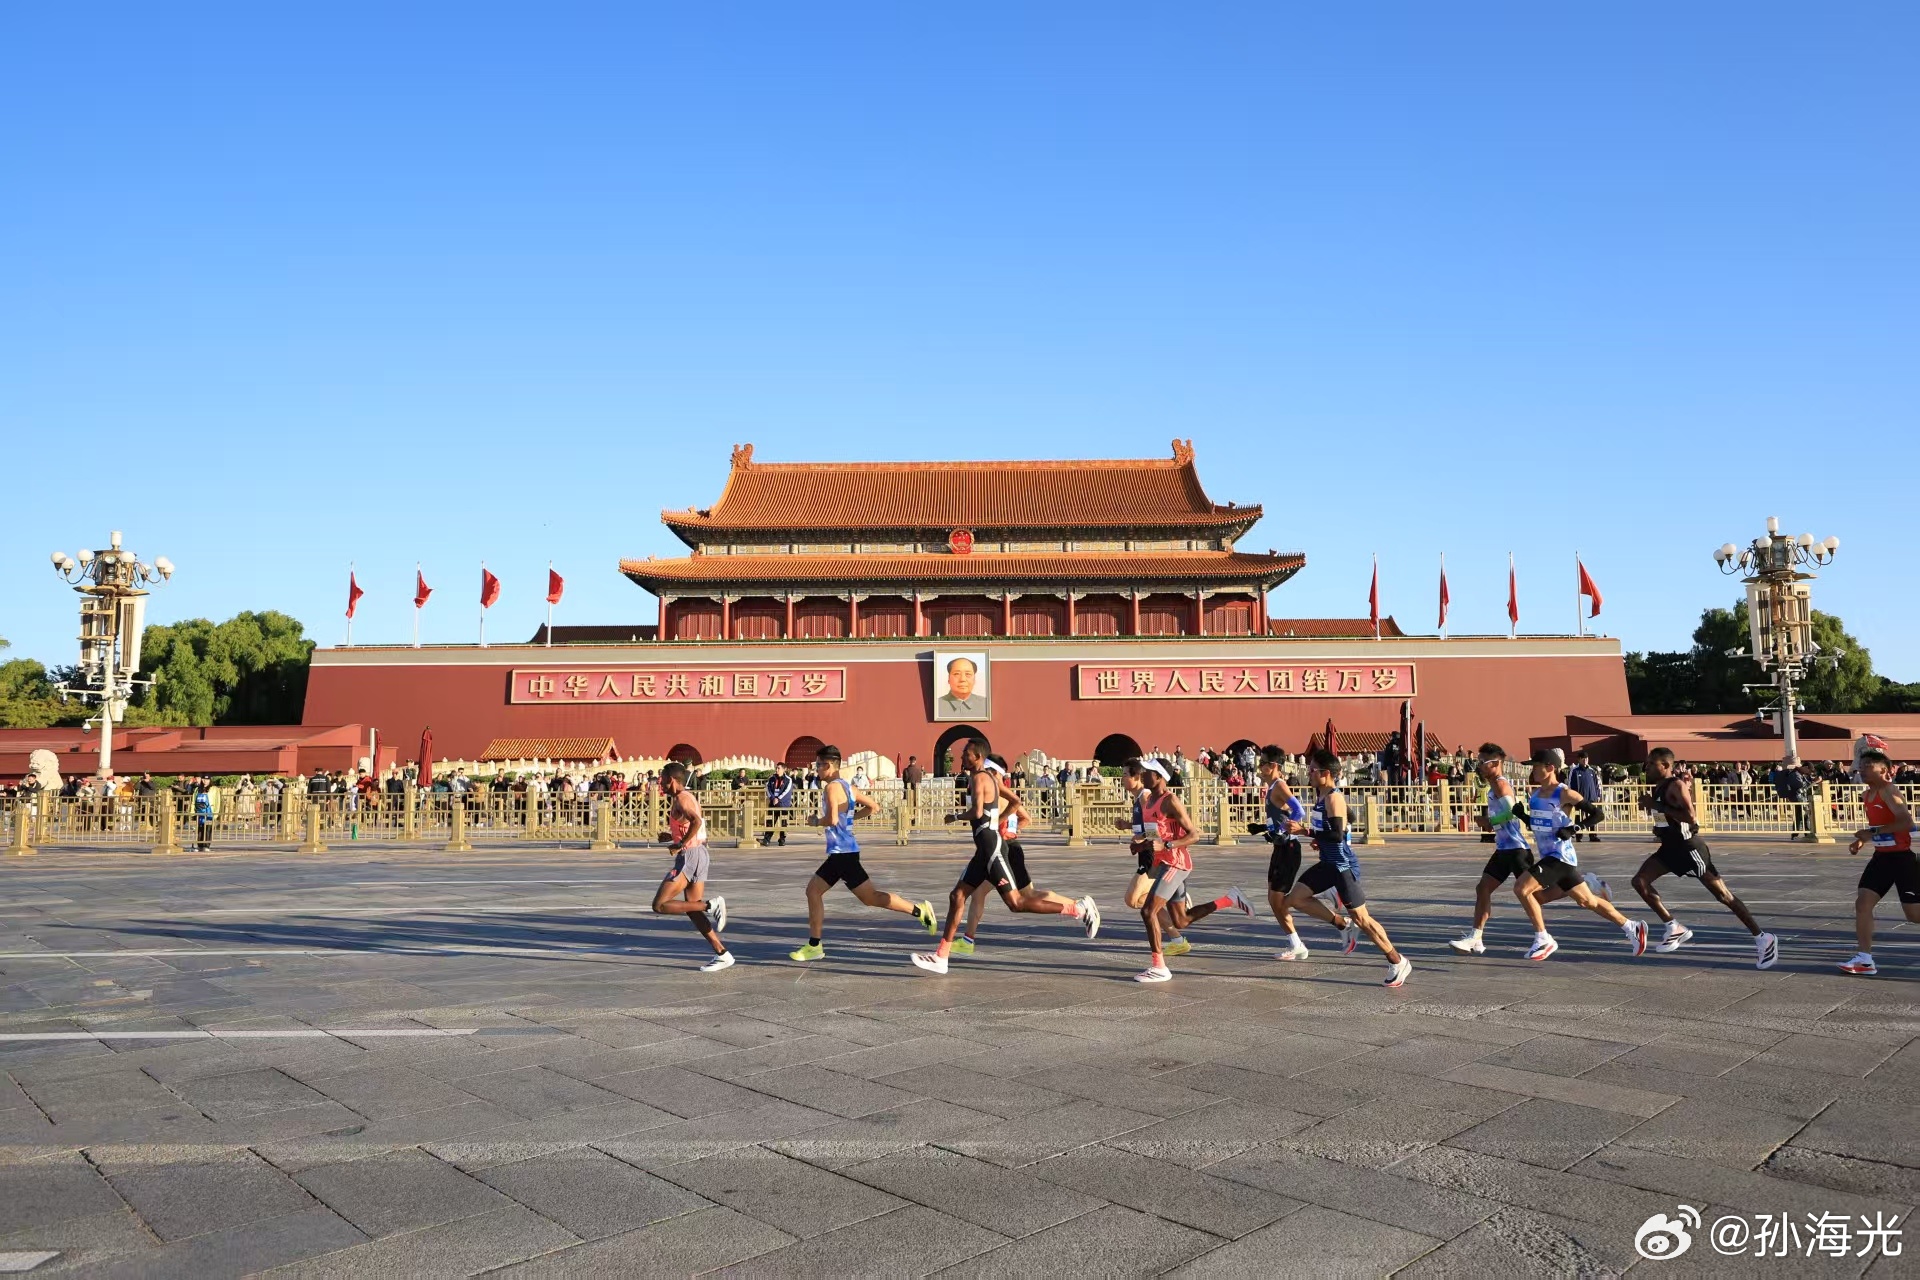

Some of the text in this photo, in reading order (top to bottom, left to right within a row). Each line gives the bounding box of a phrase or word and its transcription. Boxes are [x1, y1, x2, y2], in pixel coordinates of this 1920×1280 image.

[529, 673, 828, 698] 中华人民共和国万岁
[1096, 668, 1398, 693] 世界人民大团结万岁
